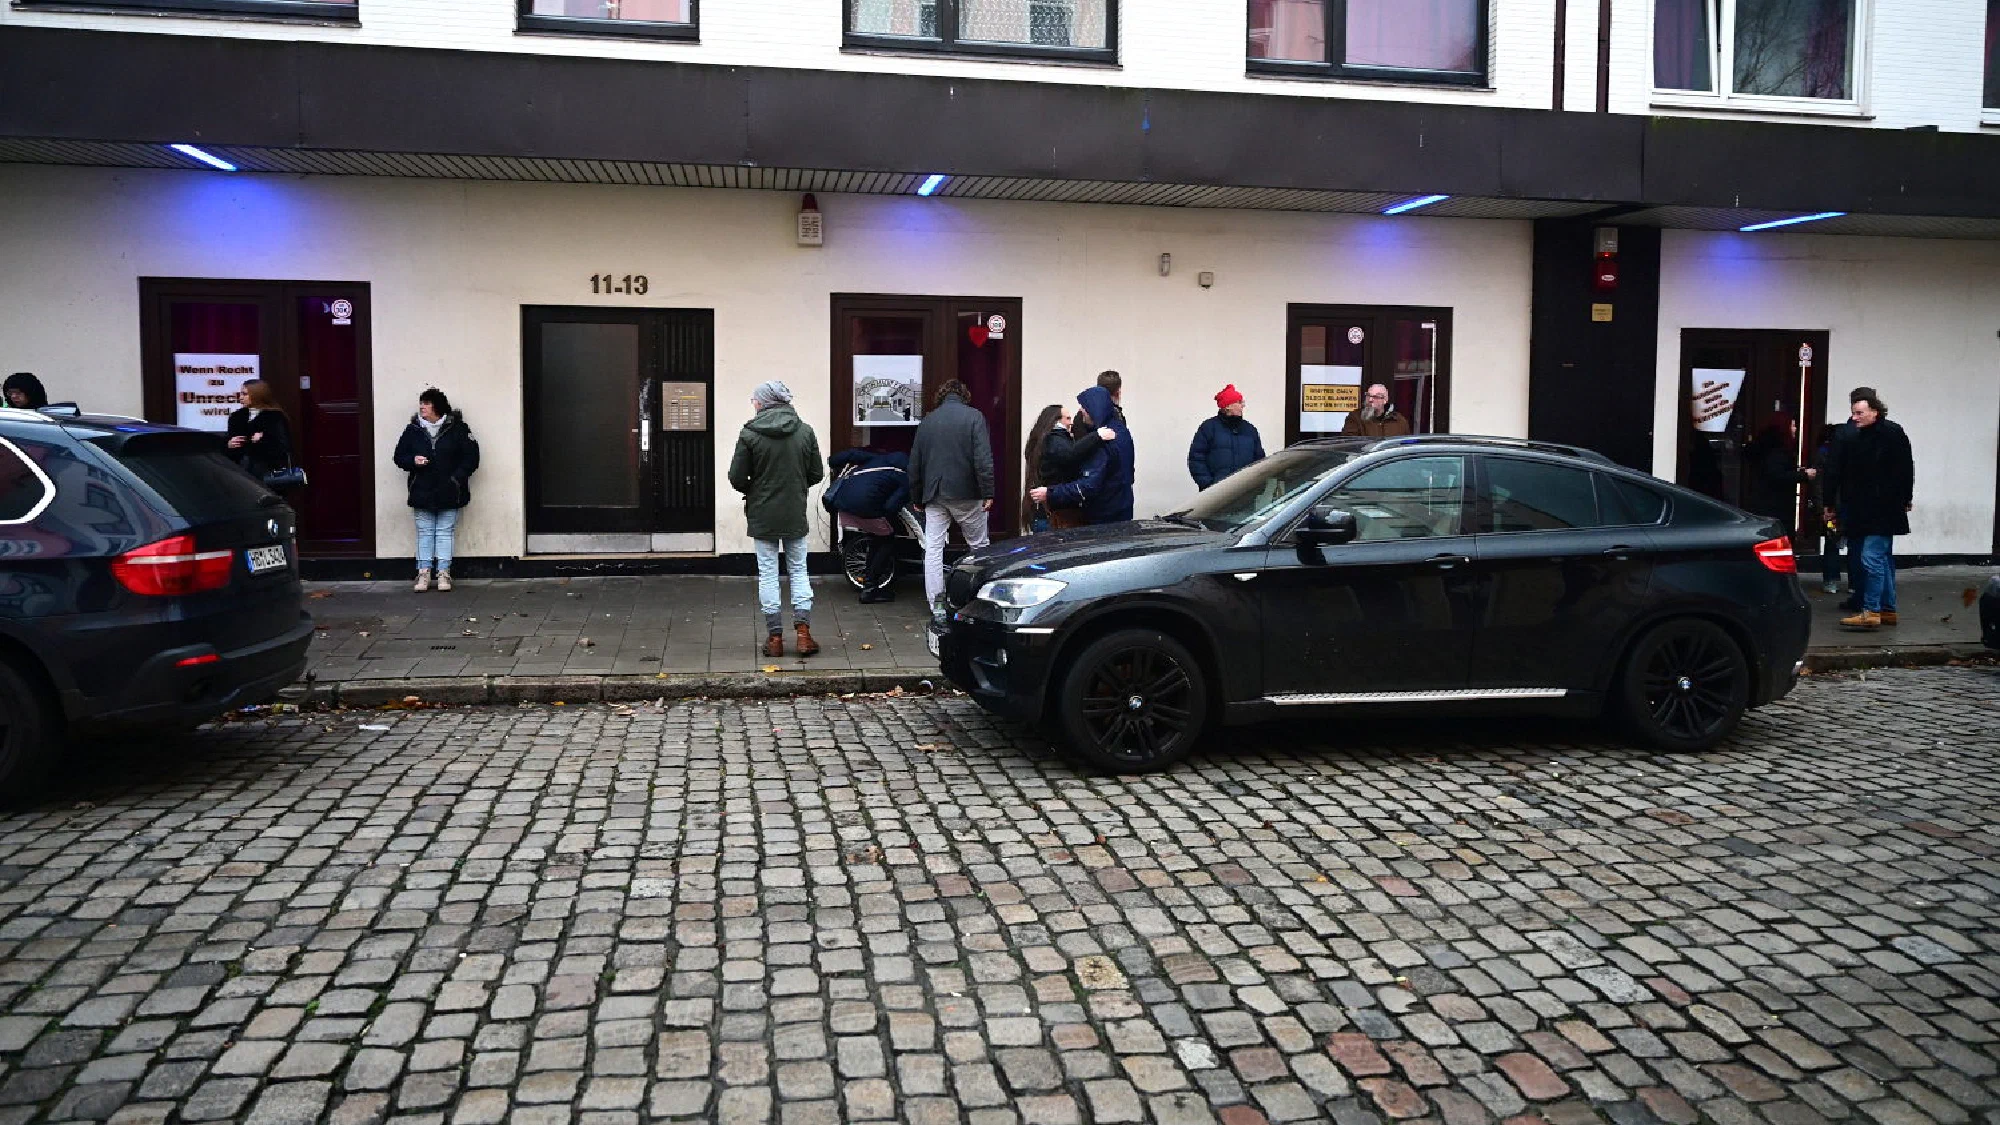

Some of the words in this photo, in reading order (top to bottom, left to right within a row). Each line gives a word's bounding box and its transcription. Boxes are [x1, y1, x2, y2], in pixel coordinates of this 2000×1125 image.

[590, 274, 648, 295] 11-13
[179, 365, 214, 374] Wenn
[217, 366, 254, 374] Recht
[181, 391, 243, 404] Unrec
[202, 407, 230, 416] wird
